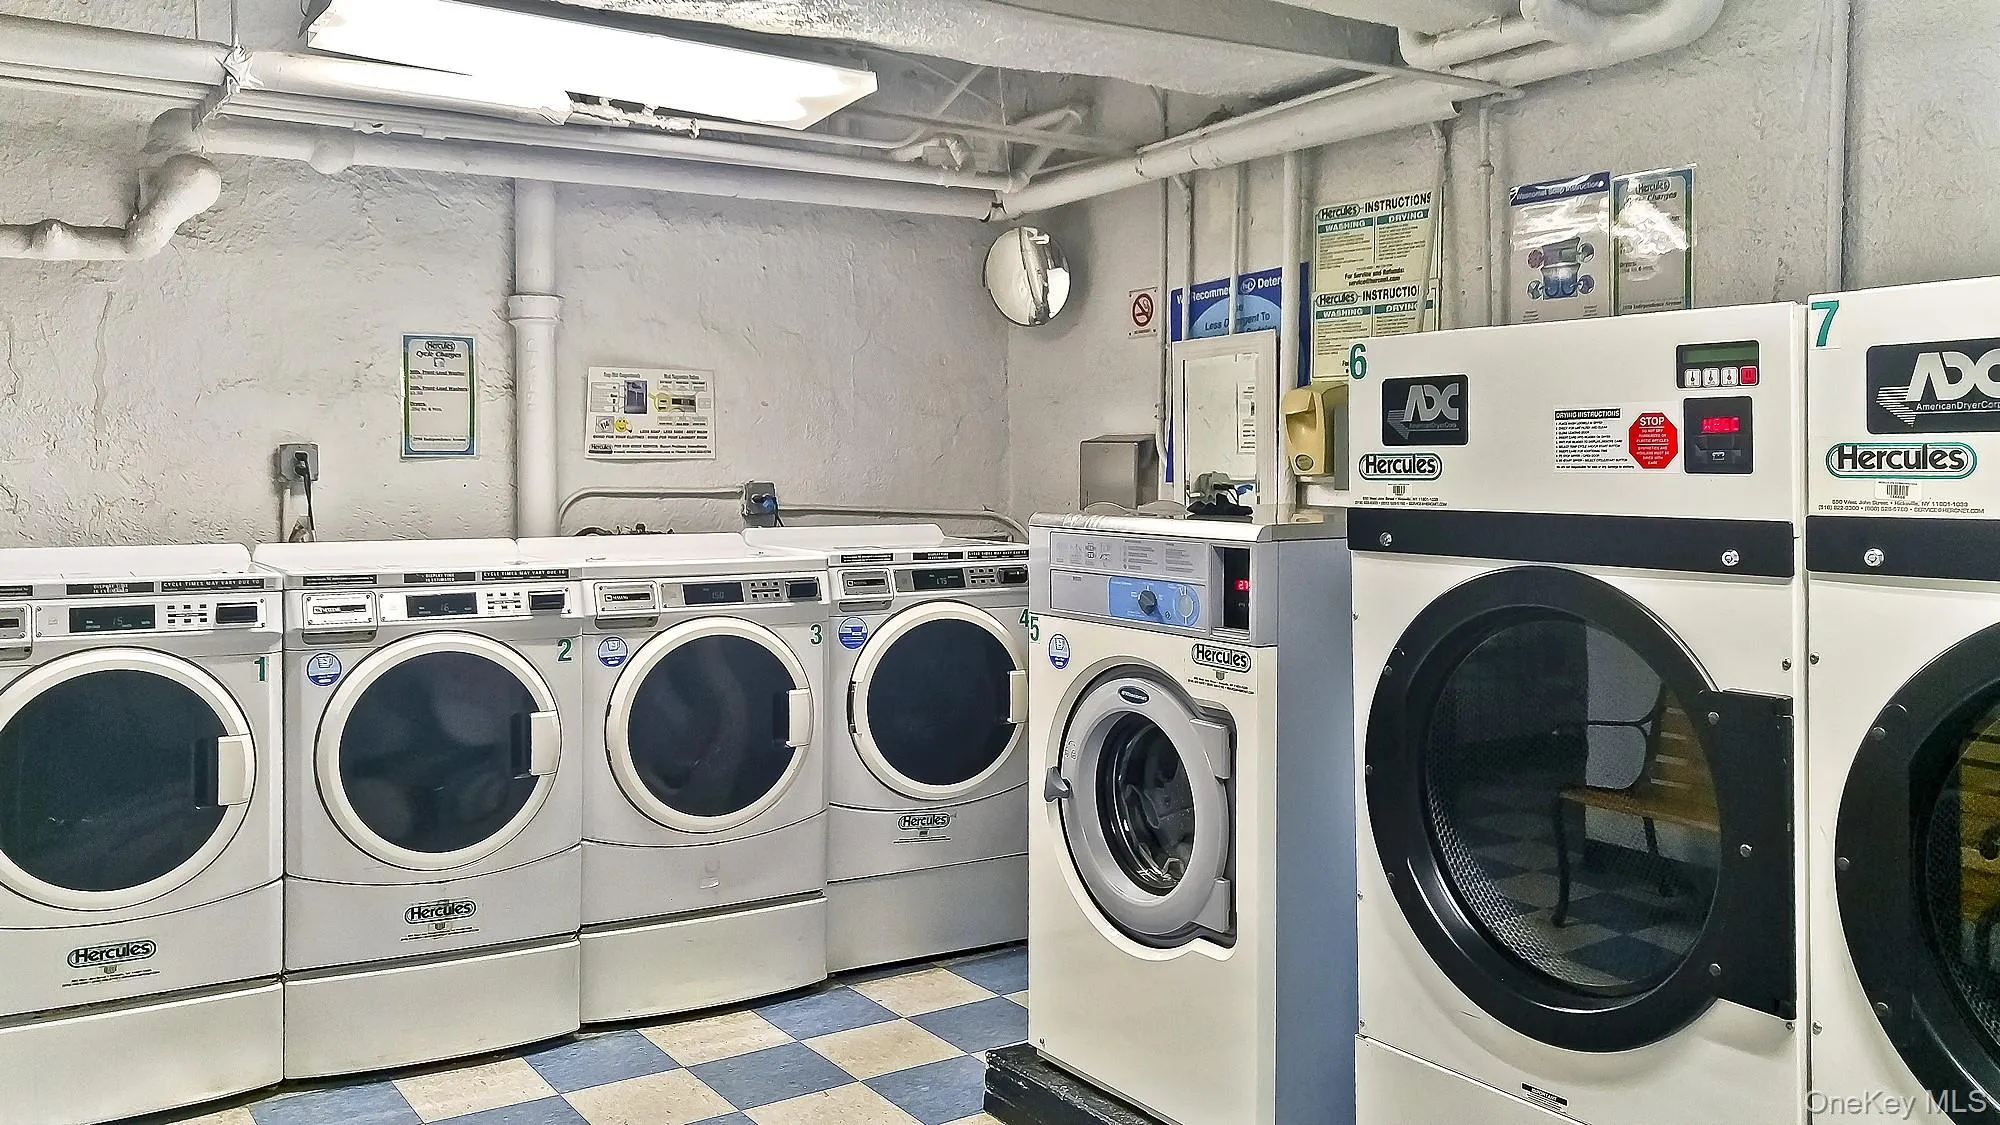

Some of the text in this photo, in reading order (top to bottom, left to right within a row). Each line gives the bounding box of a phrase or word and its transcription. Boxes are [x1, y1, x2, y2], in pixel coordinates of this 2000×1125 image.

[1364, 191, 1431, 213] INSTRUCTIONS
[1325, 220, 1366, 233] WASHING
[1388, 211, 1424, 223] DRYING
[1323, 308, 1363, 319] WASHING
[1811, 300, 1839, 347] 7
[1349, 343, 1368, 379] 6
[1402, 382, 1459, 422] ADC
[1640, 416, 1665, 426] STOP
[1365, 453, 1436, 474] Hercules
[1837, 443, 1966, 470] Hercules
[1019, 609, 1029, 627] 4
[1030, 616, 1040, 641] 5
[810, 624, 823, 645] 3
[557, 638, 572, 661] 2
[1196, 643, 1248, 668] Hercules
[254, 656, 266, 681] 1
[902, 814, 947, 827] Hercules
[410, 903, 471, 920] Hercules
[75, 942, 150, 963] Hercules
